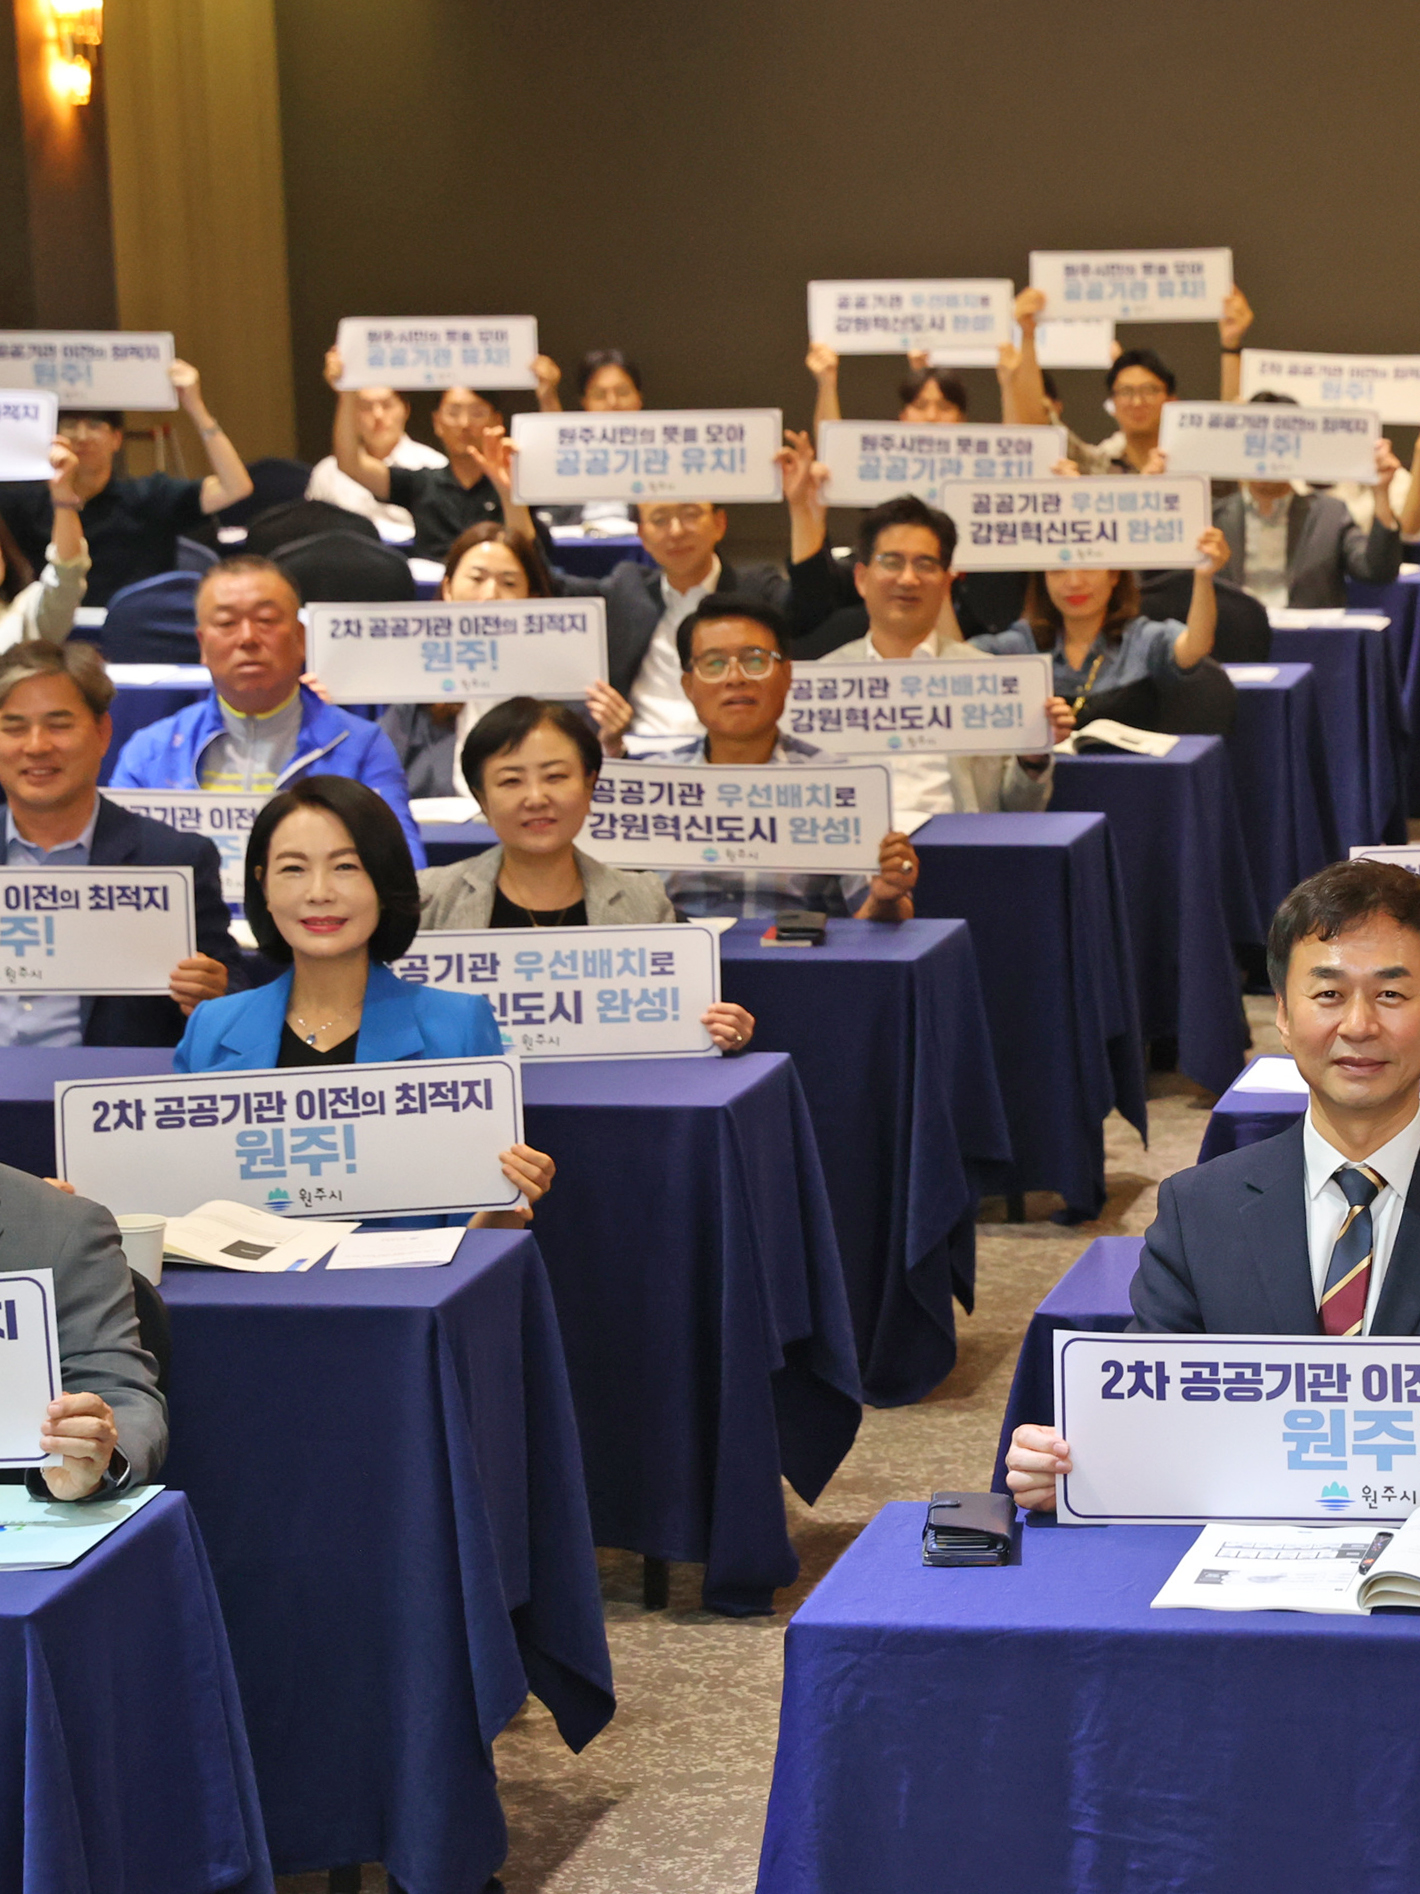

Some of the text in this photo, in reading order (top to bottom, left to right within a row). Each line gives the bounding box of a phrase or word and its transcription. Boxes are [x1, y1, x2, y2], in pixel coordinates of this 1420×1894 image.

[556, 448, 670, 477] 공공기관
[330, 617, 363, 639] 2차
[368, 616, 453, 640] 공공기관
[420, 639, 499, 673] 원주!
[791, 673, 1020, 702] 공공기관 우선배치로
[790, 703, 1024, 734] 강원혁신도시 완성!
[592, 777, 856, 809] 공공기관 우선배치로
[209, 806, 257, 830] 이전
[588, 811, 861, 846] 강원혁신도시 완성!
[5, 884, 169, 912] 이전의 최적지
[0, 915, 55, 958] 주!
[399, 947, 675, 985] 공기관 우선배치로
[596, 986, 680, 1023] 완성!
[521, 1033, 561, 1051] 원주시
[92, 1077, 494, 1133] 2차 공공기관 이전의 최적지
[235, 1122, 358, 1181] 원주!
[298, 1186, 343, 1208] 원주시
[1100, 1359, 1171, 1402] 2차
[1180, 1360, 1352, 1404] 공공기관
[1360, 1484, 1418, 1510] 원주시
